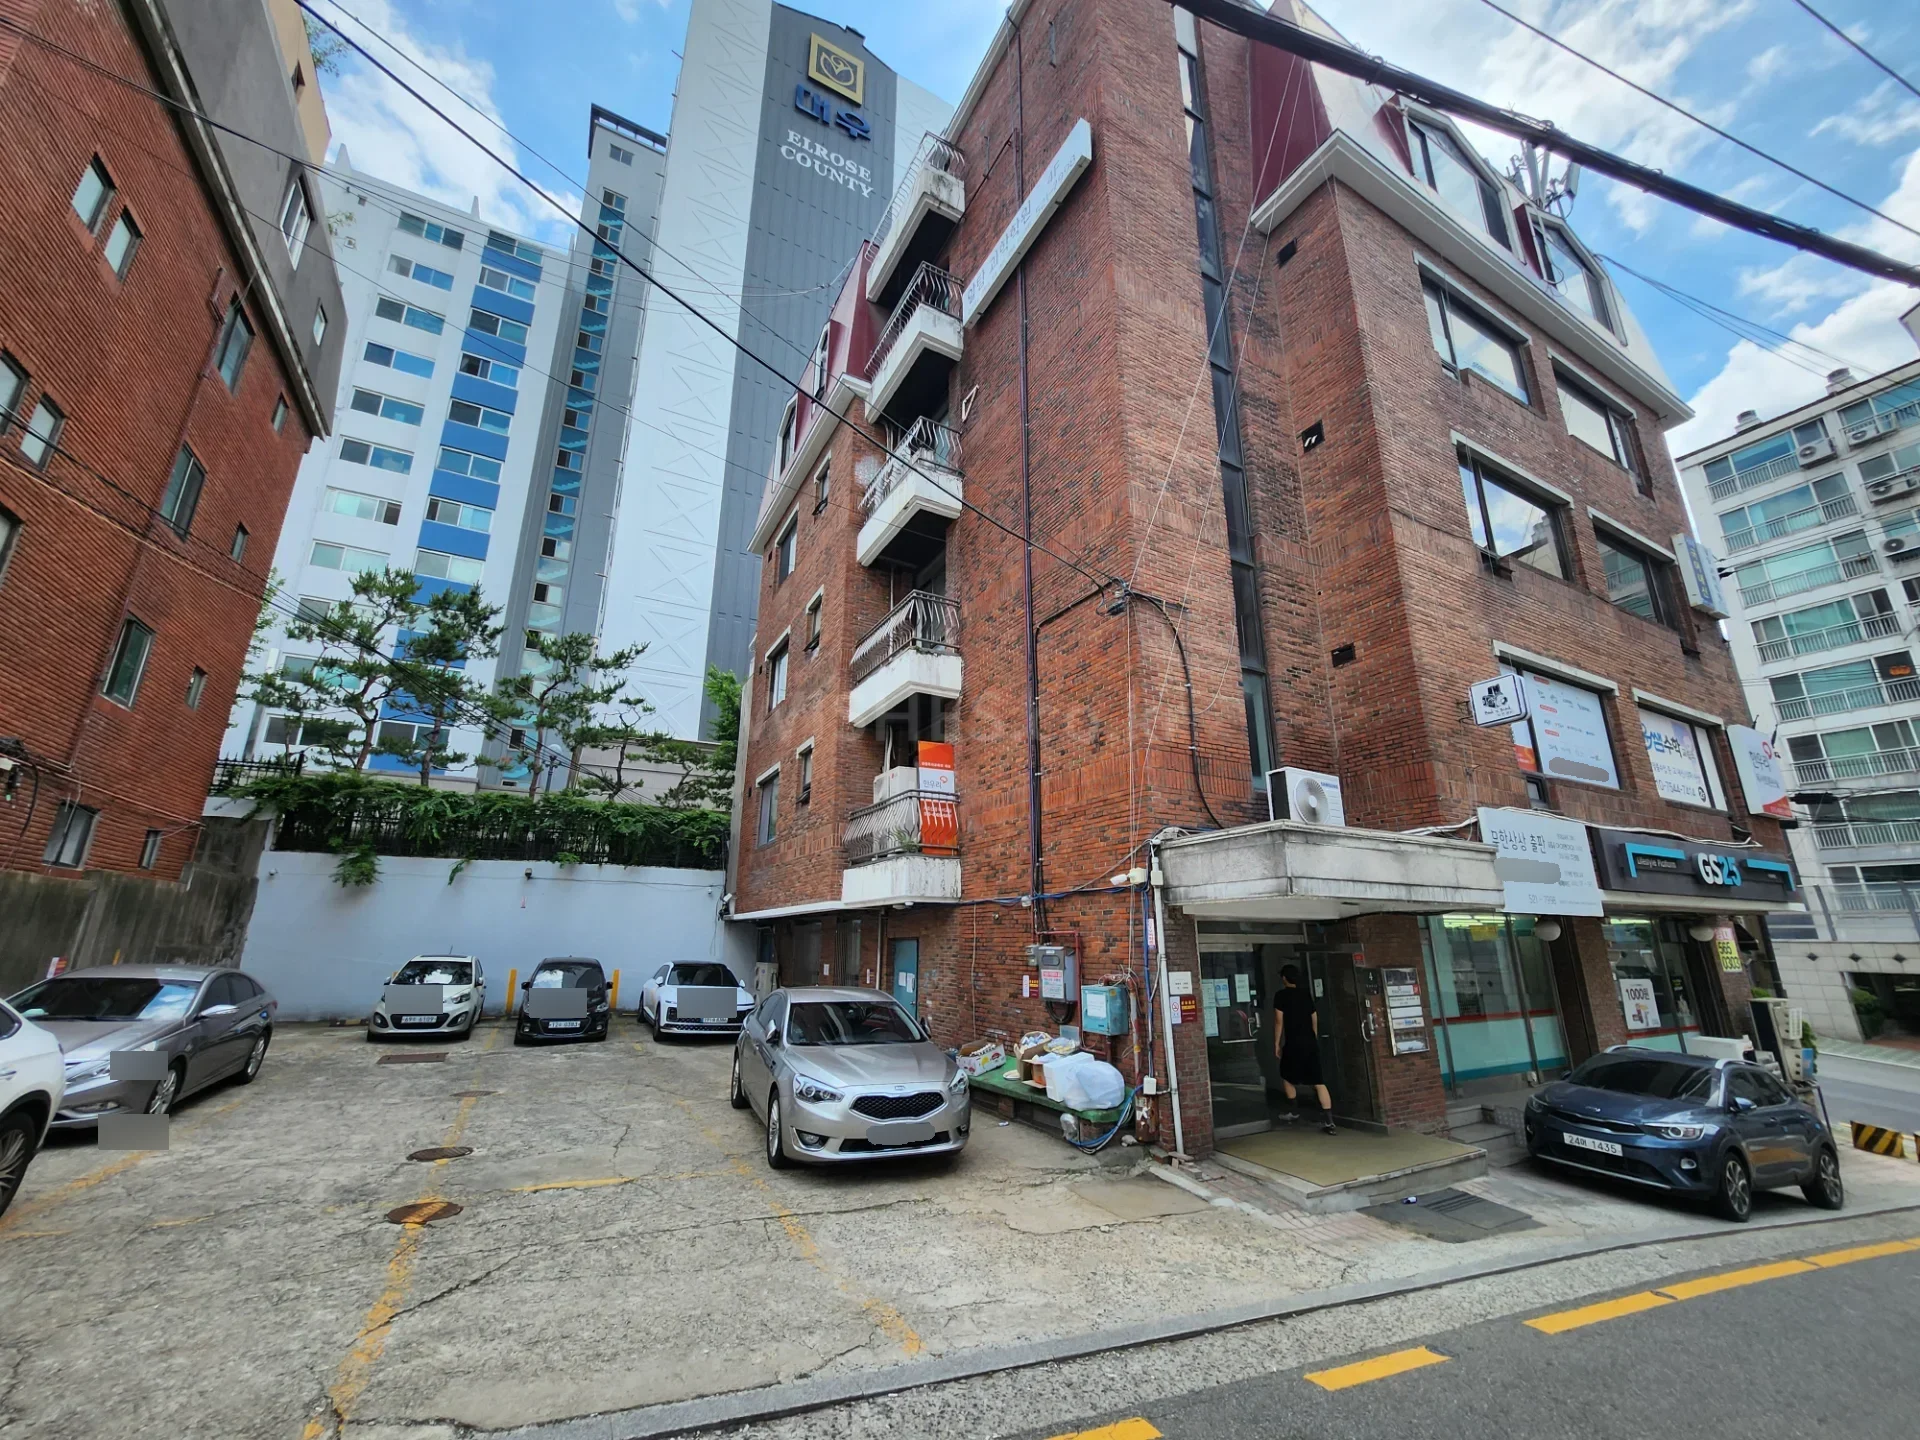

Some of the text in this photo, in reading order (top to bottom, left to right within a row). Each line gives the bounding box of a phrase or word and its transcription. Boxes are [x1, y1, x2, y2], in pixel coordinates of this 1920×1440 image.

[795, 84, 871, 141] 대우
[780, 146, 874, 198] COUNTY
[787, 130, 872, 182] ELROSE
[1530, 833, 1547, 855] 출판
[1697, 852, 1741, 887] GS25
[1591, 1140, 1617, 1154] 1435
